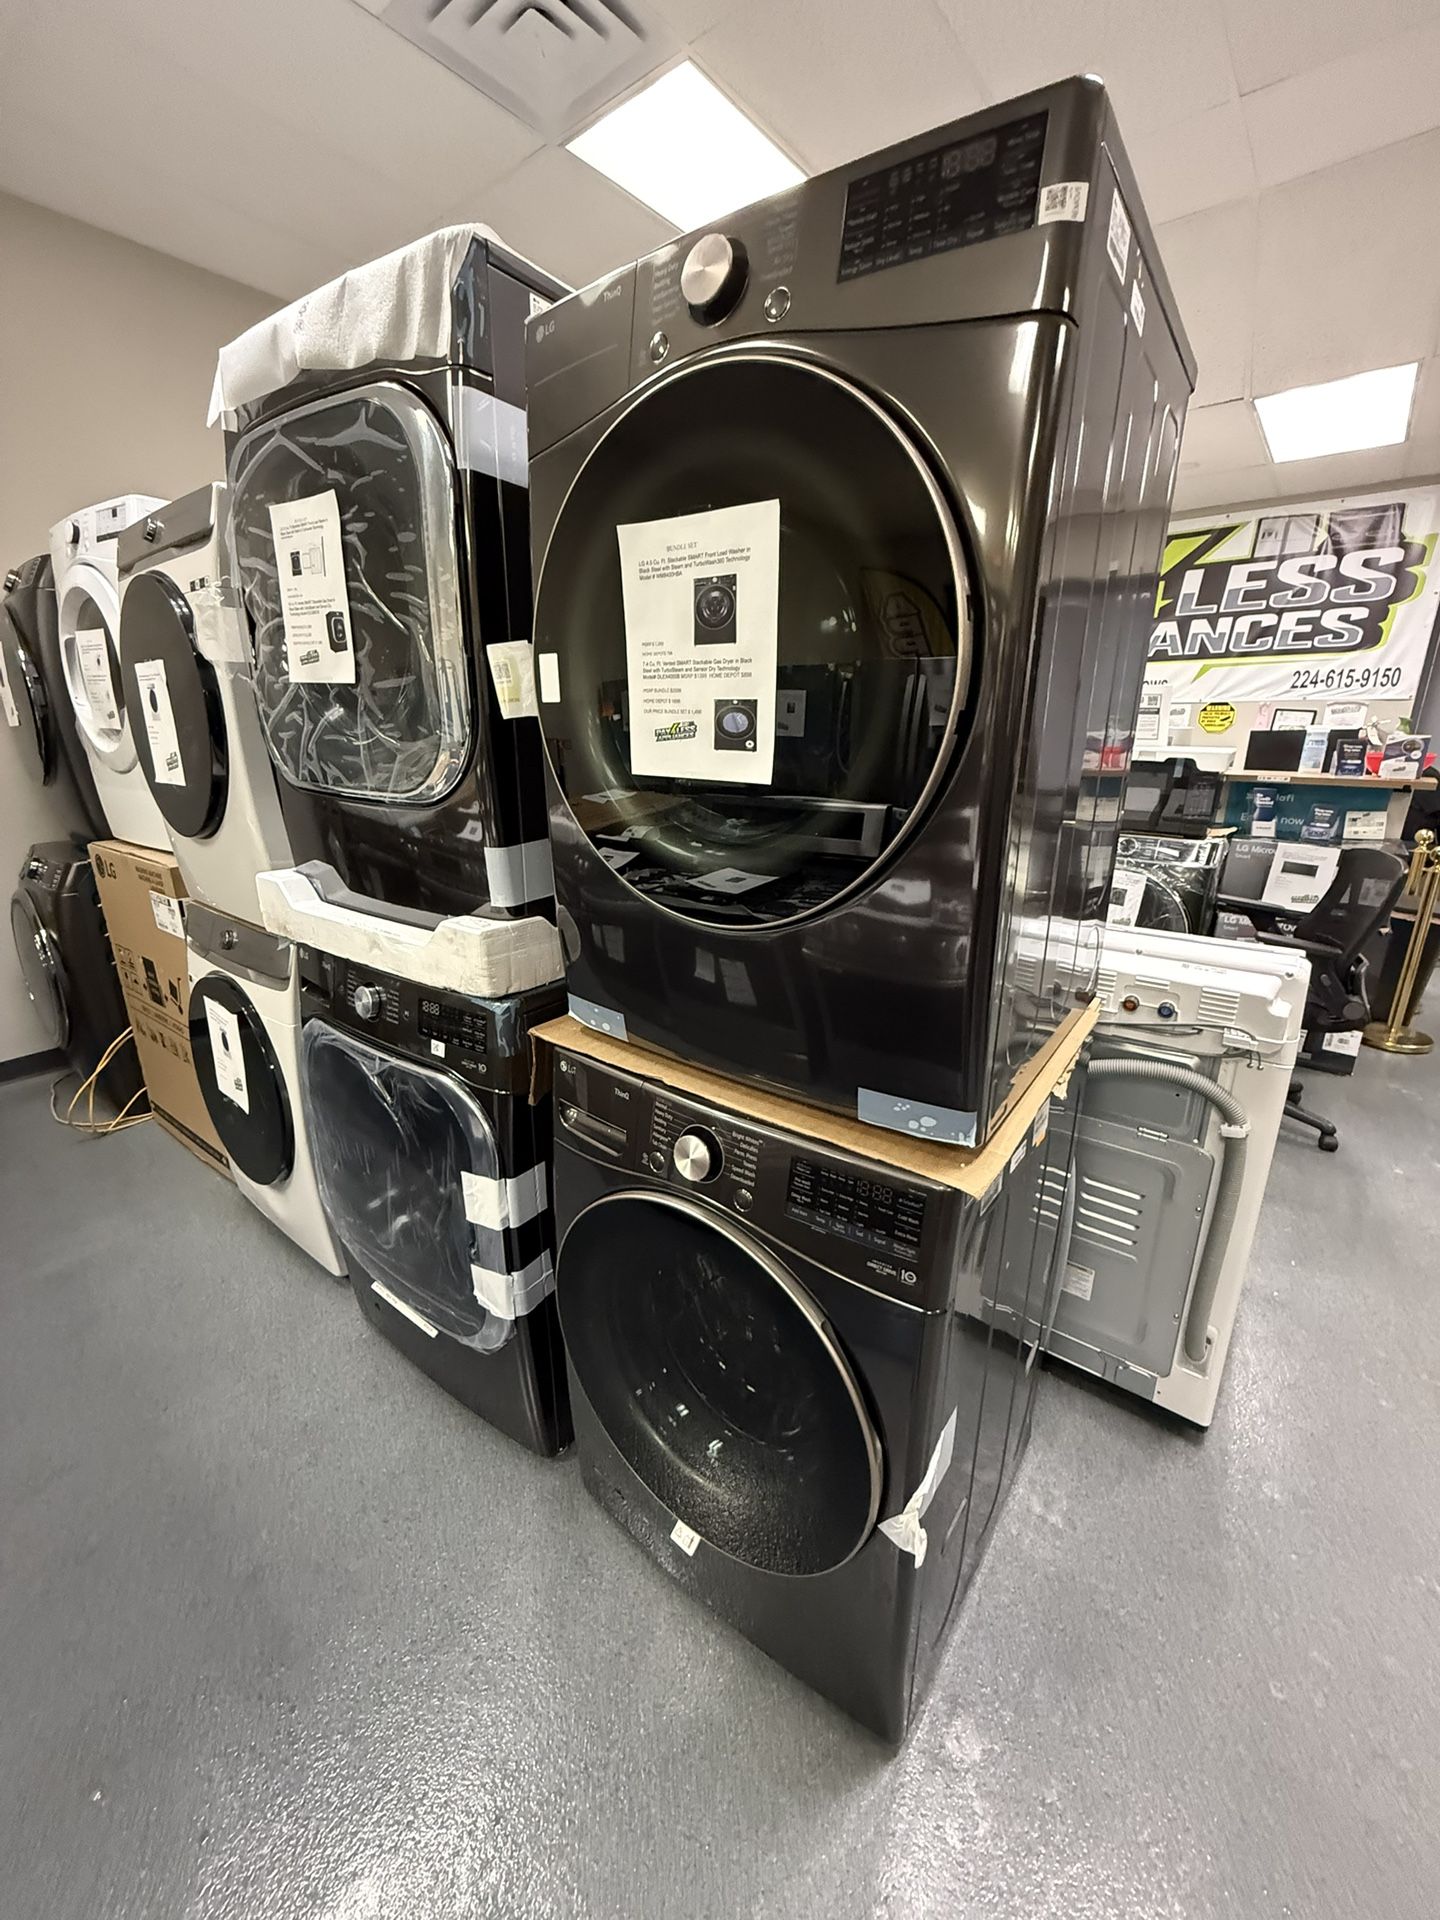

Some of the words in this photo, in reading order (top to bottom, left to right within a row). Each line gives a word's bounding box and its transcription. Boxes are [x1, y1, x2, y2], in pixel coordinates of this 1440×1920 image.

[545, 320, 555, 336] LG
[1175, 547, 1405, 617] LESS
[1291, 666, 1402, 690] 224-615-9150
[1236, 843, 1249, 853] LG
[104, 859, 117, 879] LG
[1224, 916, 1237, 924] LG
[568, 1064, 577, 1075] LG
[615, 1087, 630, 1100] ThinQ
